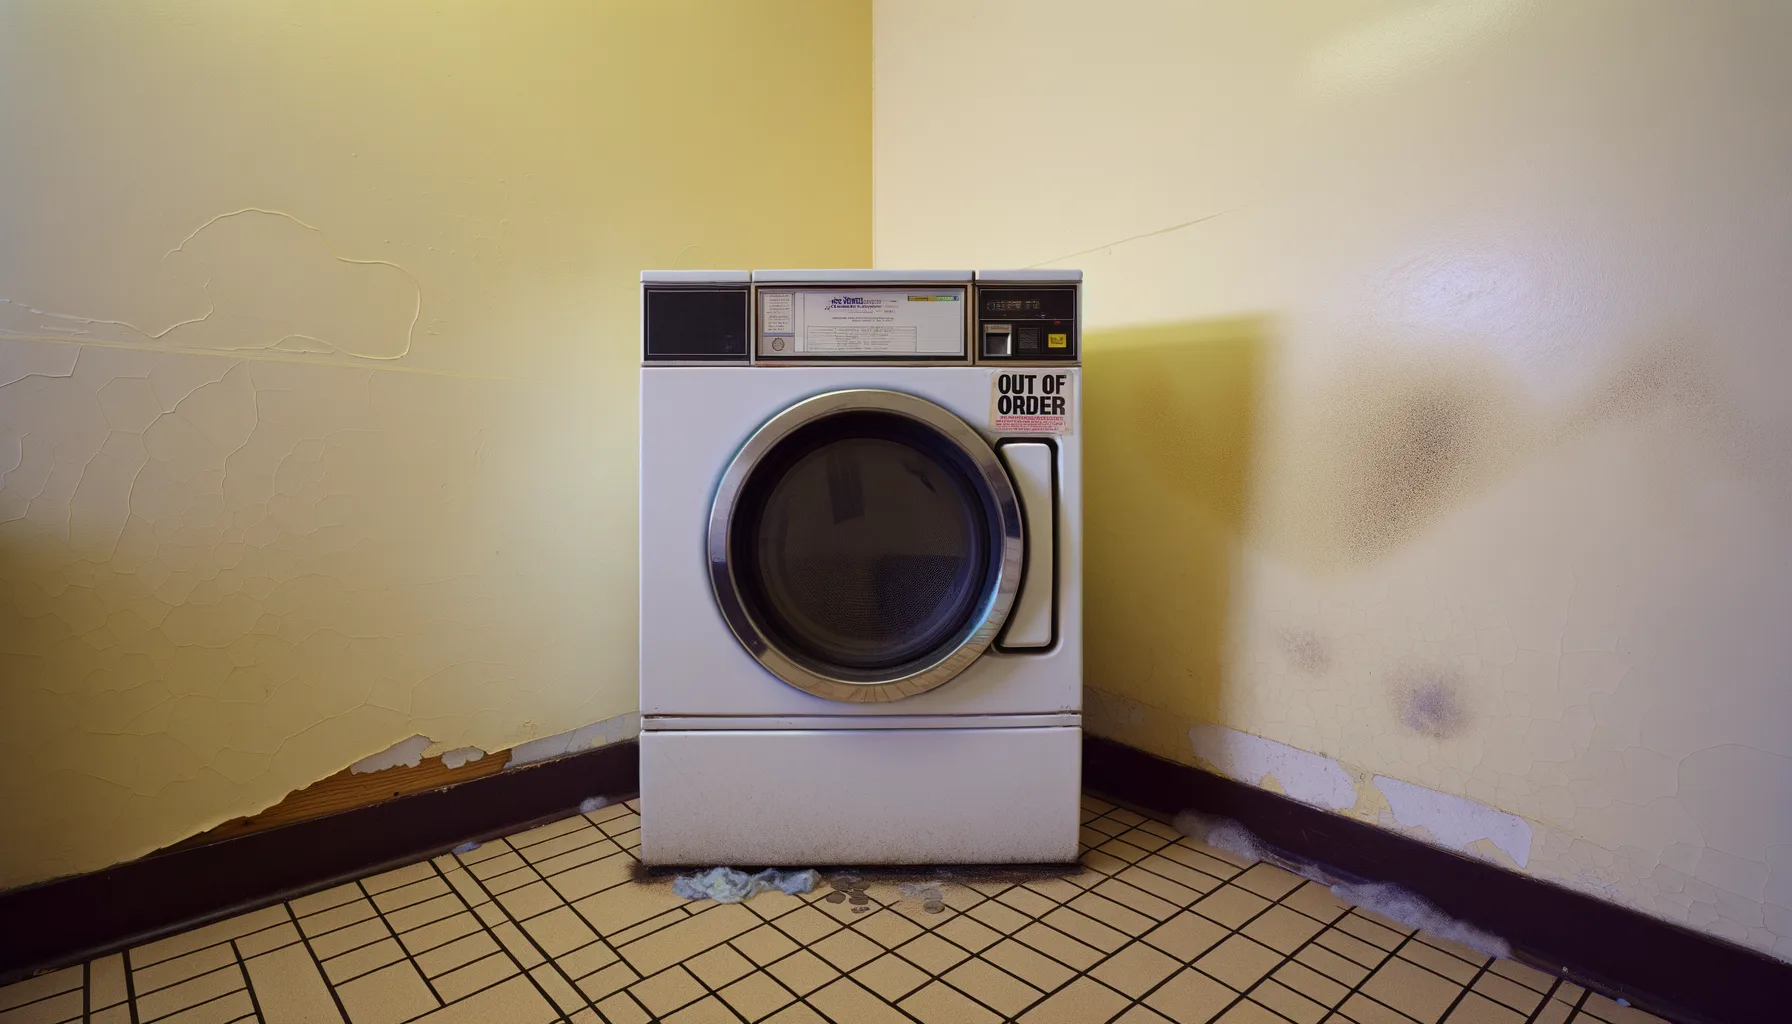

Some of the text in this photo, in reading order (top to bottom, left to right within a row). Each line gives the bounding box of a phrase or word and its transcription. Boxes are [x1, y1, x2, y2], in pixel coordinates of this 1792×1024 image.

[998, 374, 1066, 394] OUT OF
[997, 395, 1066, 415] ORDER
